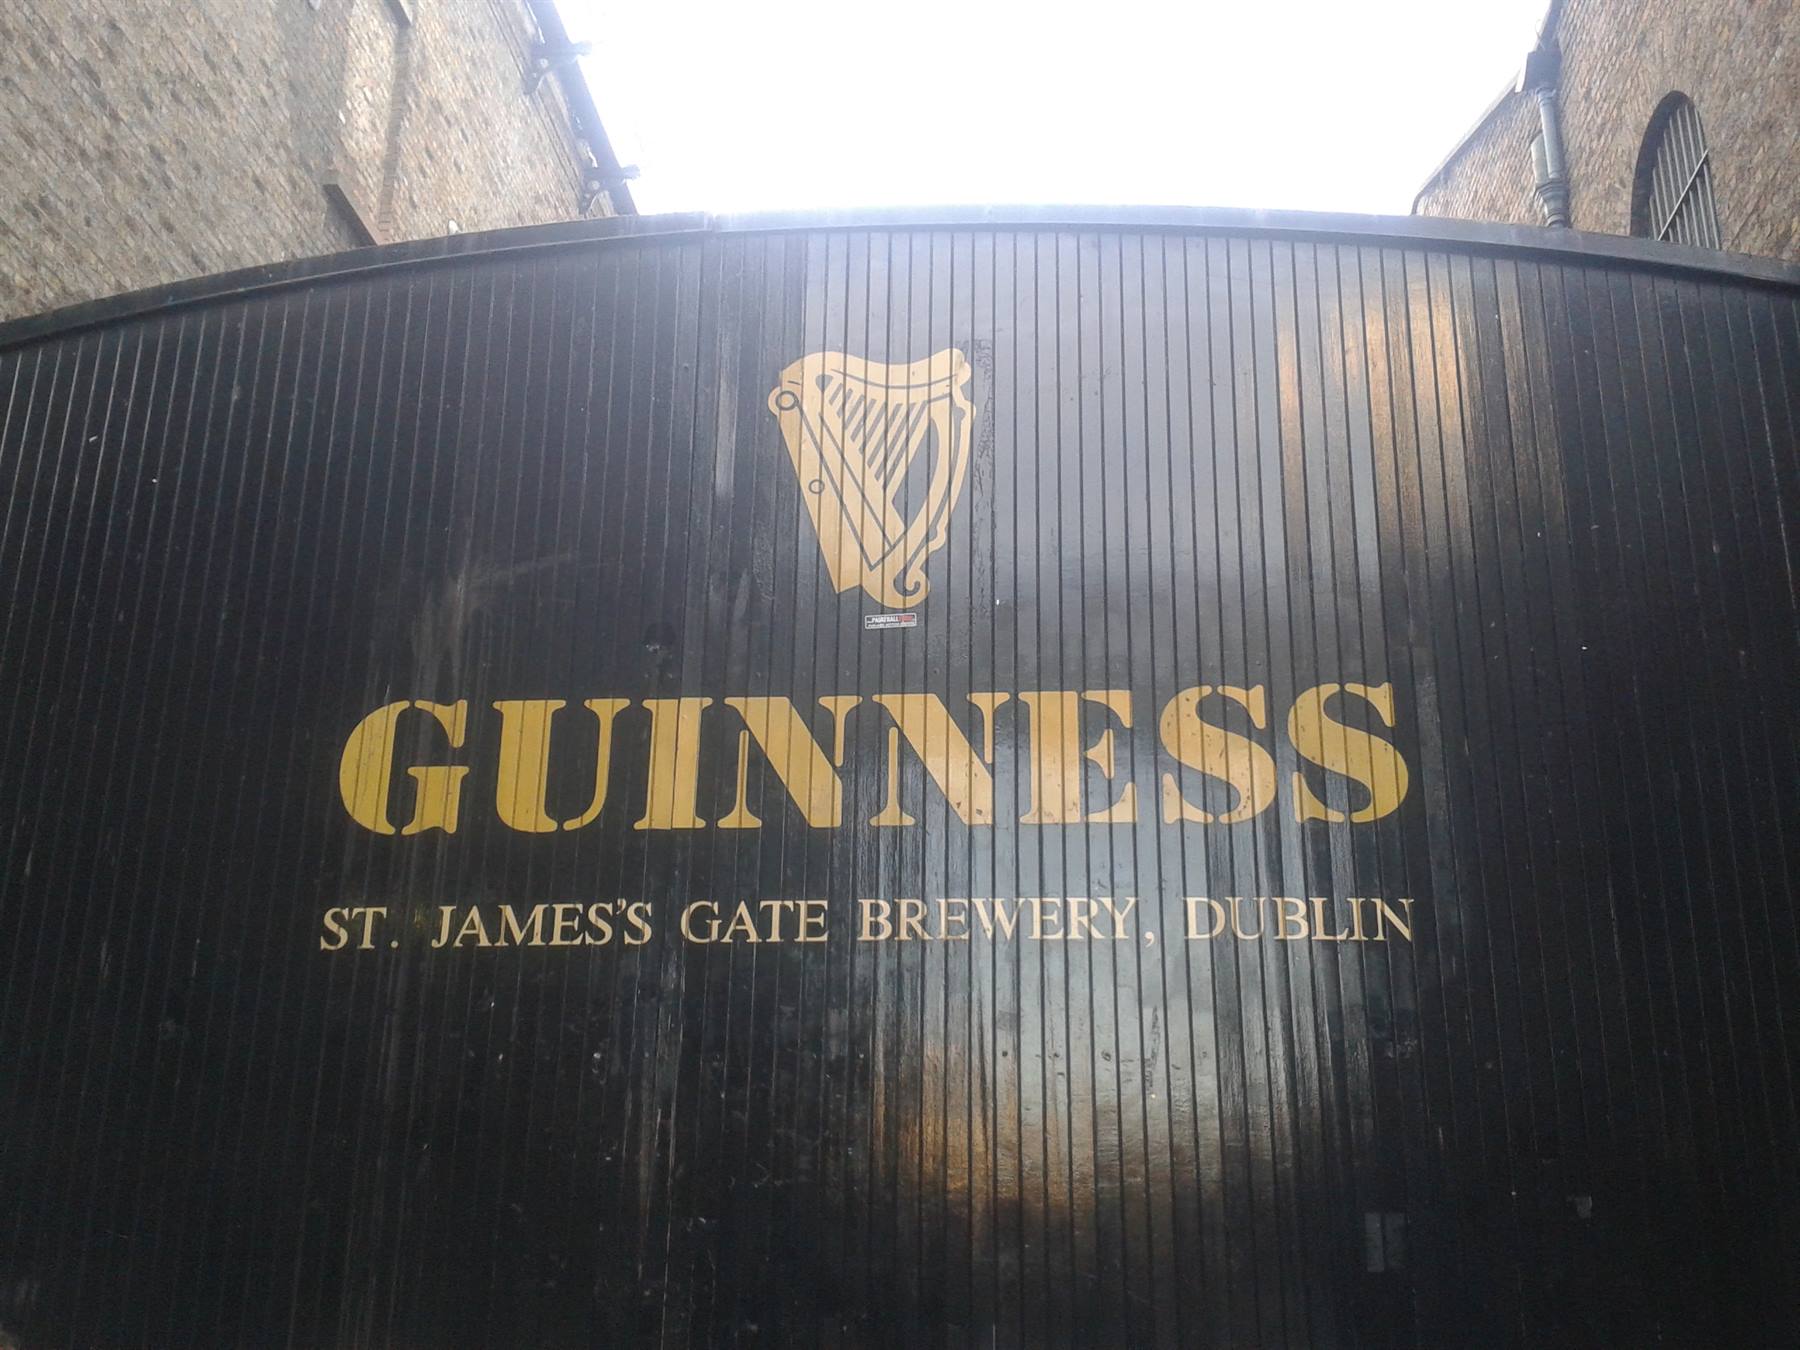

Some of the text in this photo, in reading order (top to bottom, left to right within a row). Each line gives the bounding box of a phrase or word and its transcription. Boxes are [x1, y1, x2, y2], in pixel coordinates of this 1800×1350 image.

[339, 683, 1410, 836] GUINNESS
[320, 897, 1415, 949] ST. JAMES'S GATE BREWERY, DUBLIN
